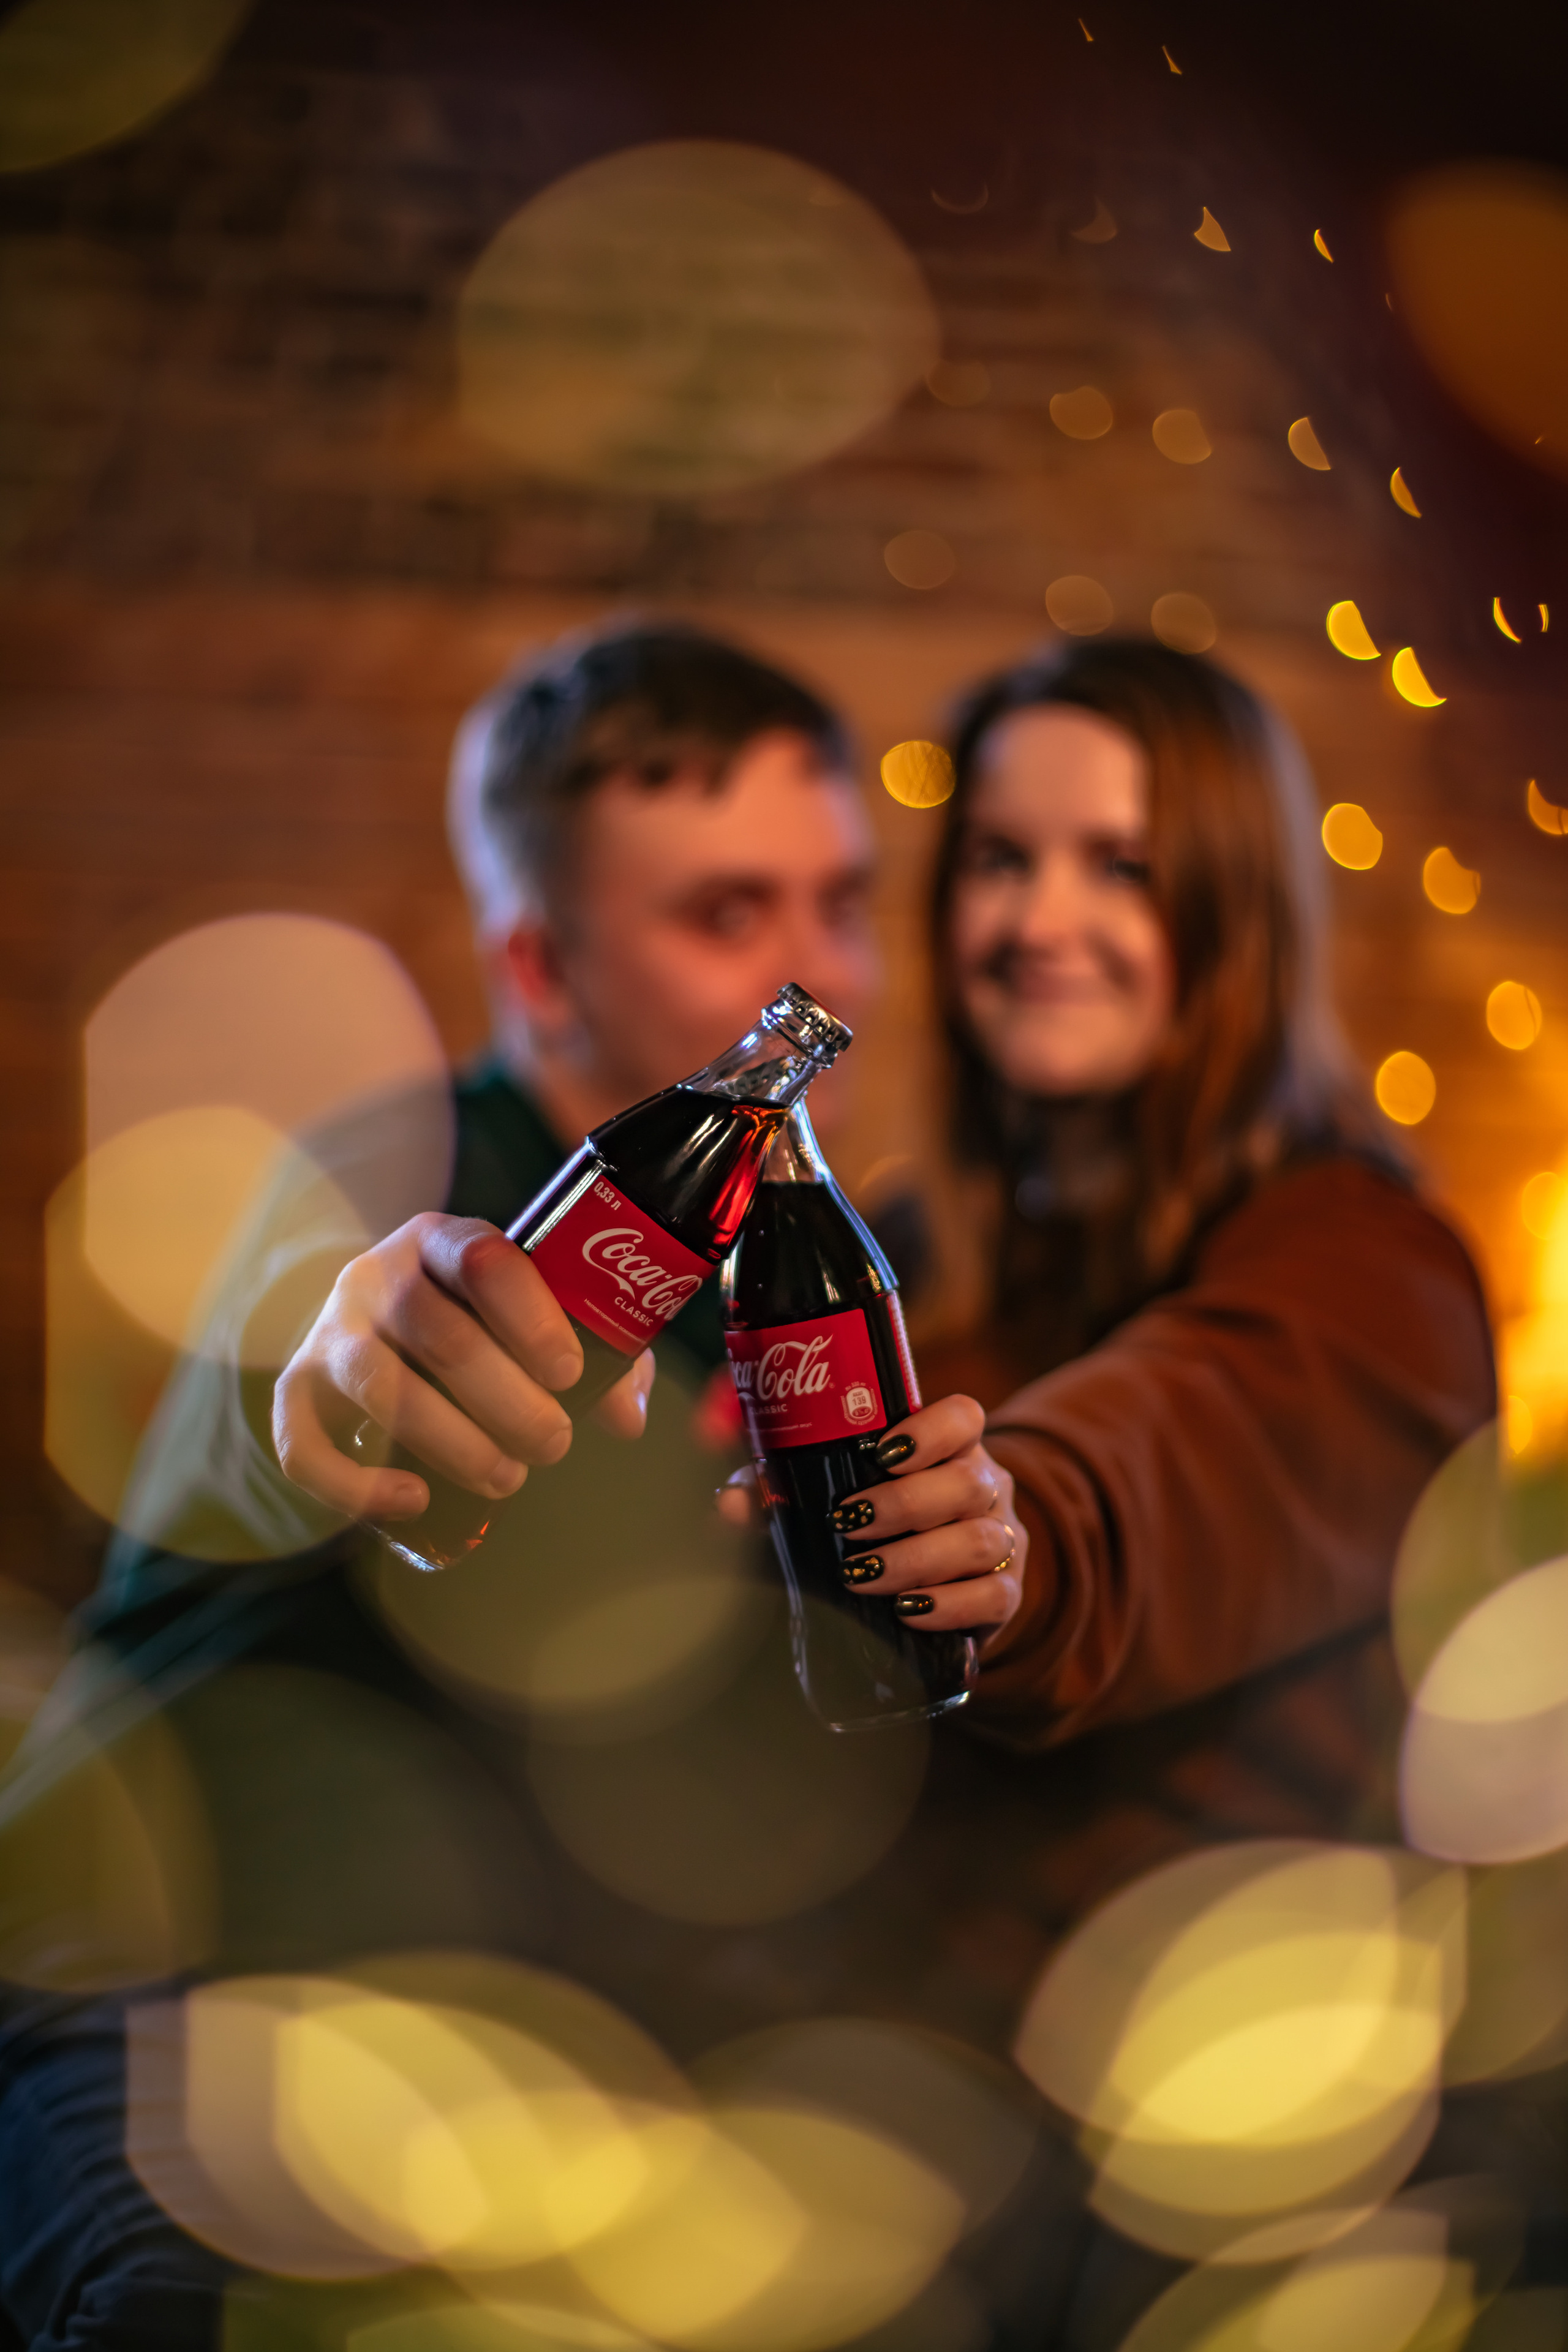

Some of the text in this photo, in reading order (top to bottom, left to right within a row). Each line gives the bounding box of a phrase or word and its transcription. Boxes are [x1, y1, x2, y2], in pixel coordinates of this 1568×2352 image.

[594, 1181, 615, 1204] 0,33
[582, 1227, 703, 1321] Coca-Col
[614, 1296, 654, 1327] CLASSIC
[726, 1333, 834, 1401] ca-Cola
[750, 1403, 788, 1415] LASSIC
[852, 1395, 866, 1406] 139
